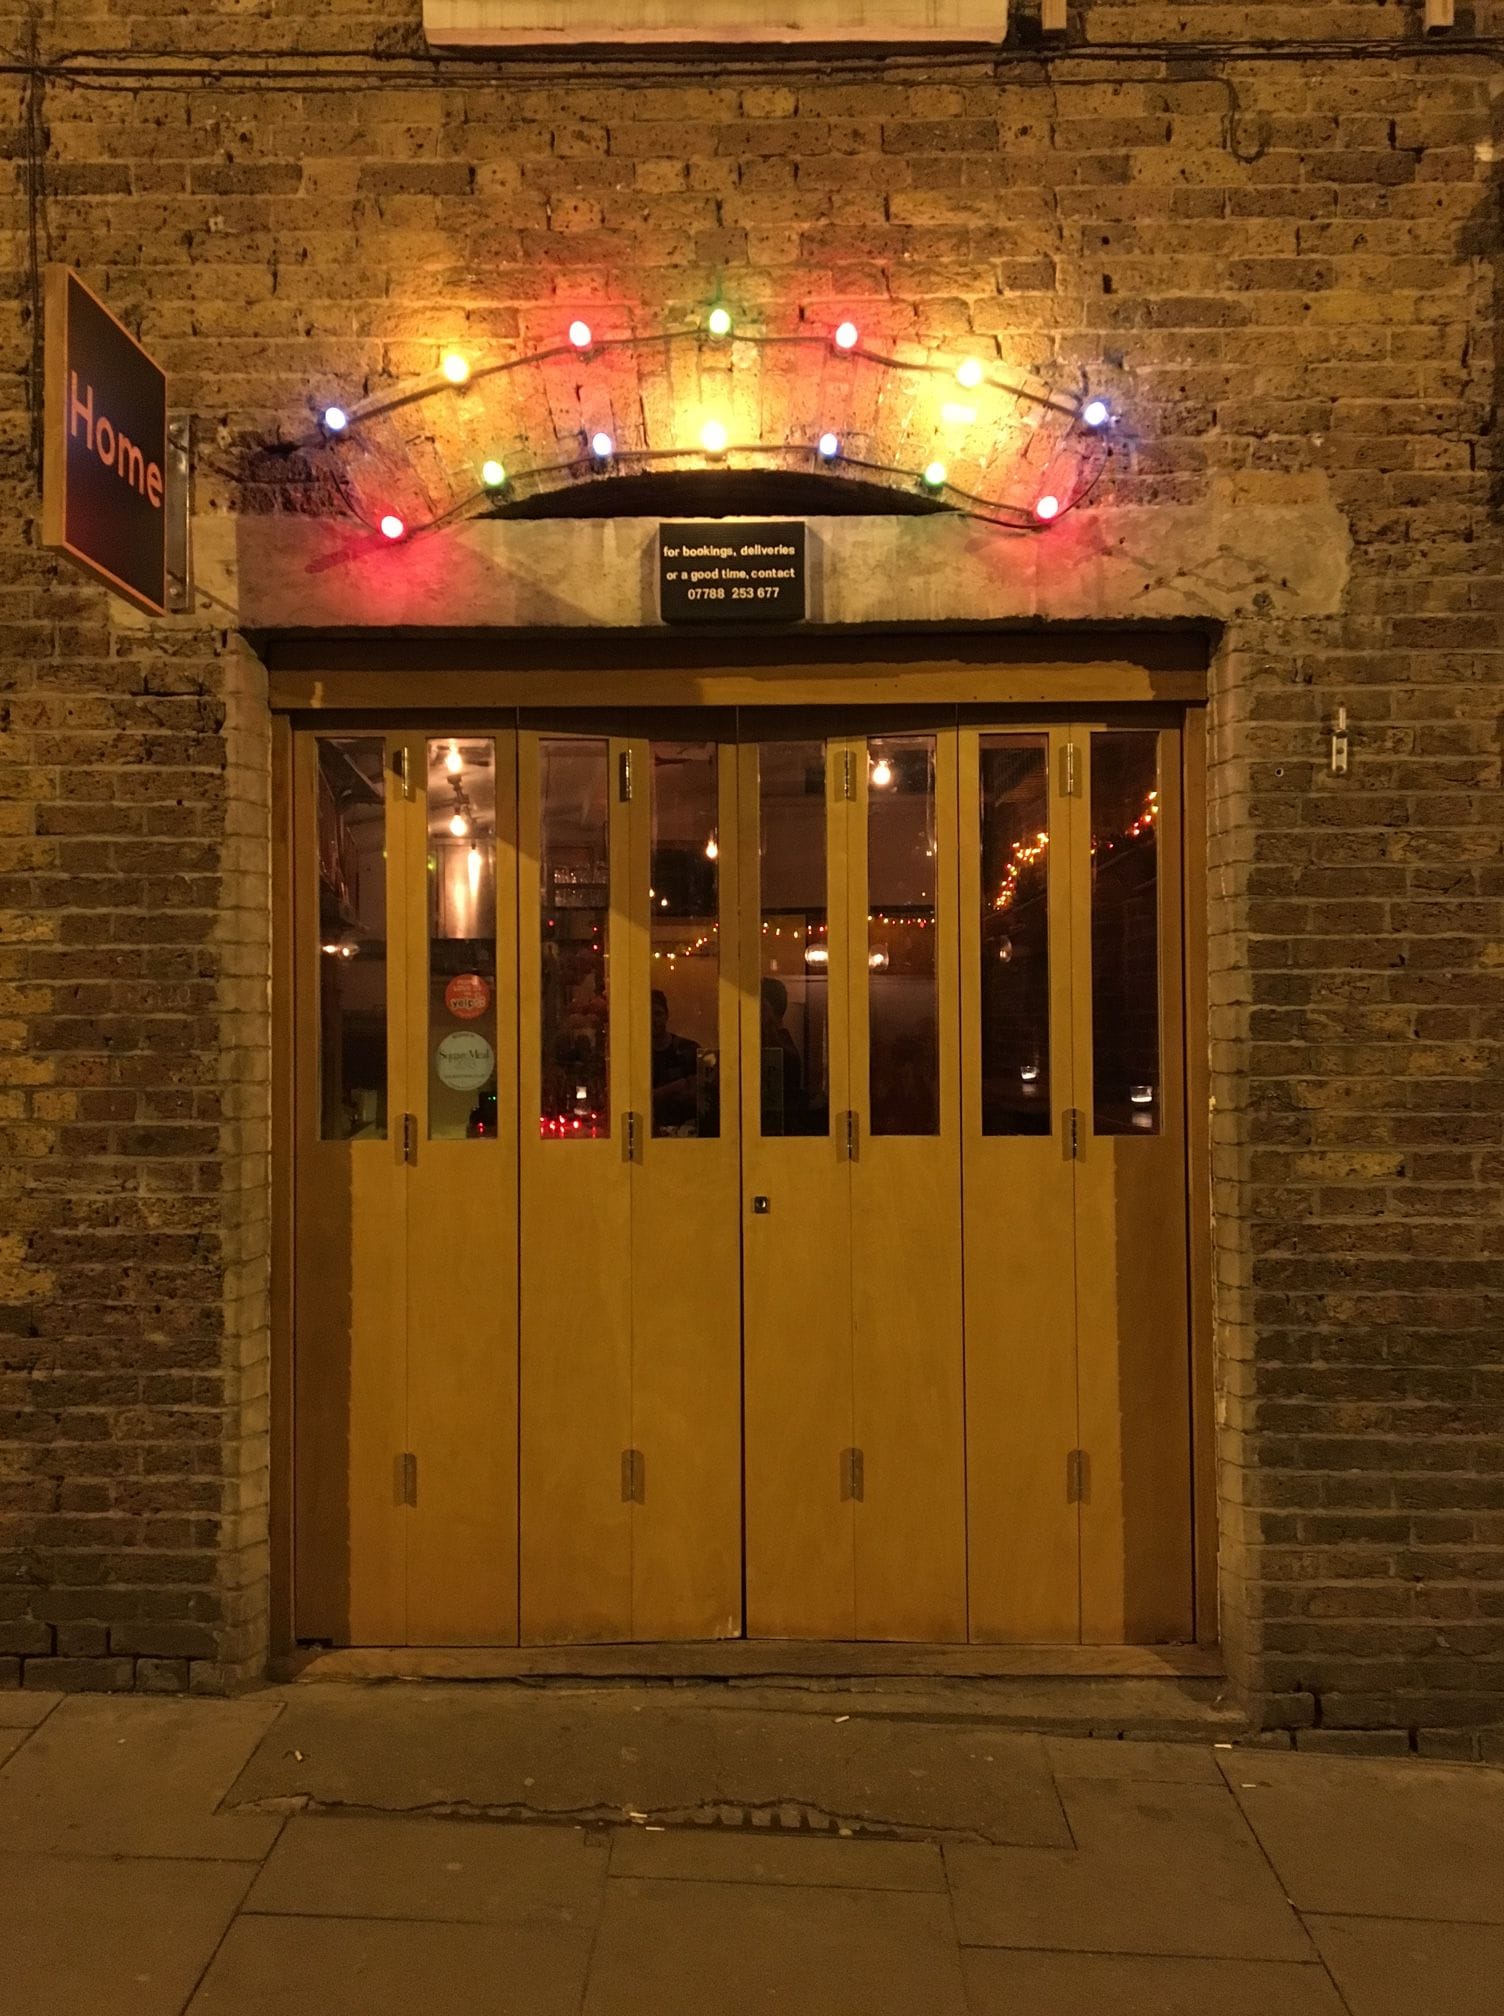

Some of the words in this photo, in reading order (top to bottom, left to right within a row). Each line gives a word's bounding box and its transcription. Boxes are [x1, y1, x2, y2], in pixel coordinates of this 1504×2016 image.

[70, 369, 163, 509] Home
[663, 545, 680, 558] for
[682, 545, 738, 558] bookings,
[740, 544, 795, 556] deliveries
[666, 571, 678, 581] or
[681, 571, 689, 580] a
[691, 568, 720, 582] good
[722, 568, 749, 580] time,
[751, 568, 795, 578] contact
[687, 588, 725, 600] 07788
[732, 587, 754, 599] 253
[757, 586, 780, 598] 677
